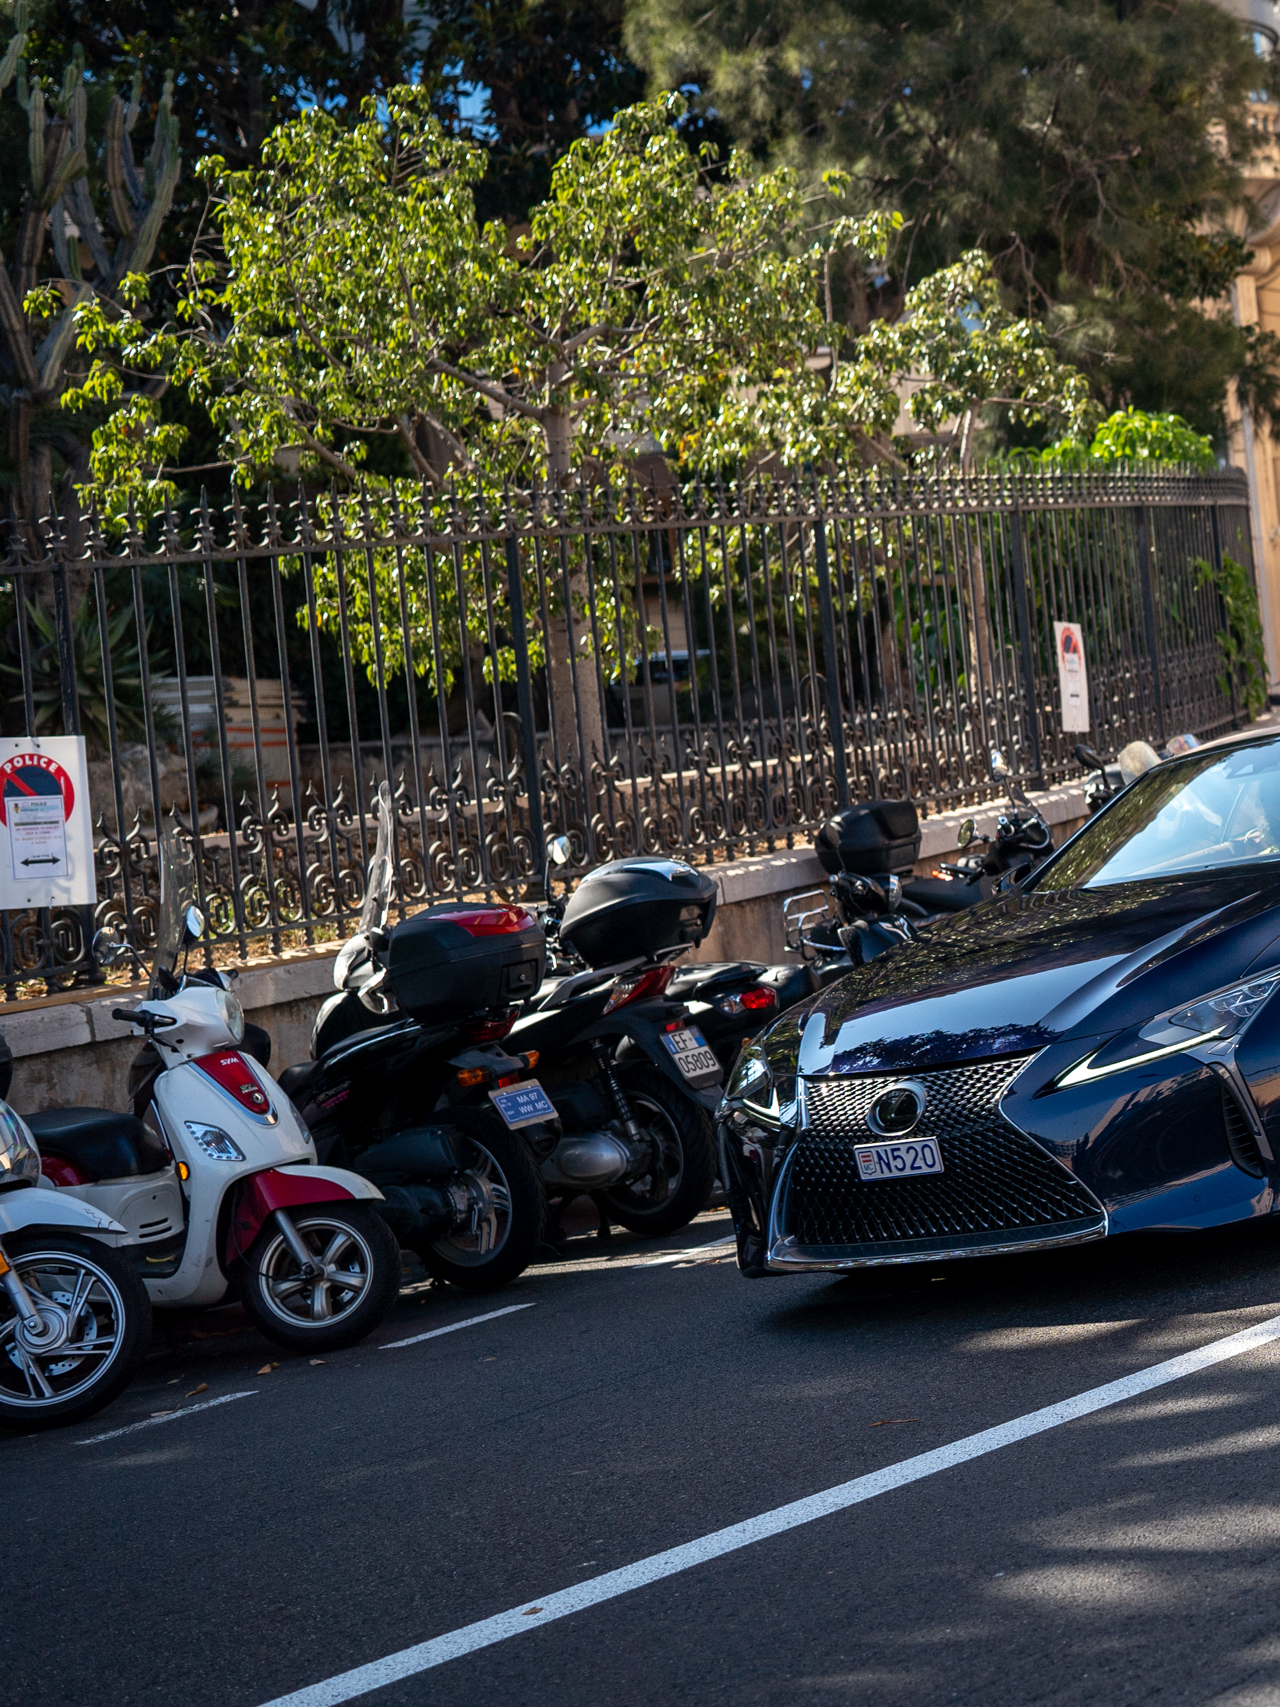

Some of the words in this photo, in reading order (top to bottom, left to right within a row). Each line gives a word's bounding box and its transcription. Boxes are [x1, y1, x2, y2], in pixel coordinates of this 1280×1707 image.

[3, 754, 59, 774] POLICE
[671, 1032, 689, 1051] EF
[220, 1057, 239, 1066] SYM
[678, 1050, 716, 1074] 05809
[516, 1094, 530, 1104] MA
[518, 1103, 534, 1114] WW
[534, 1100, 548, 1110] MC
[863, 1163, 874, 1171] MC
[876, 1144, 936, 1174] N520
